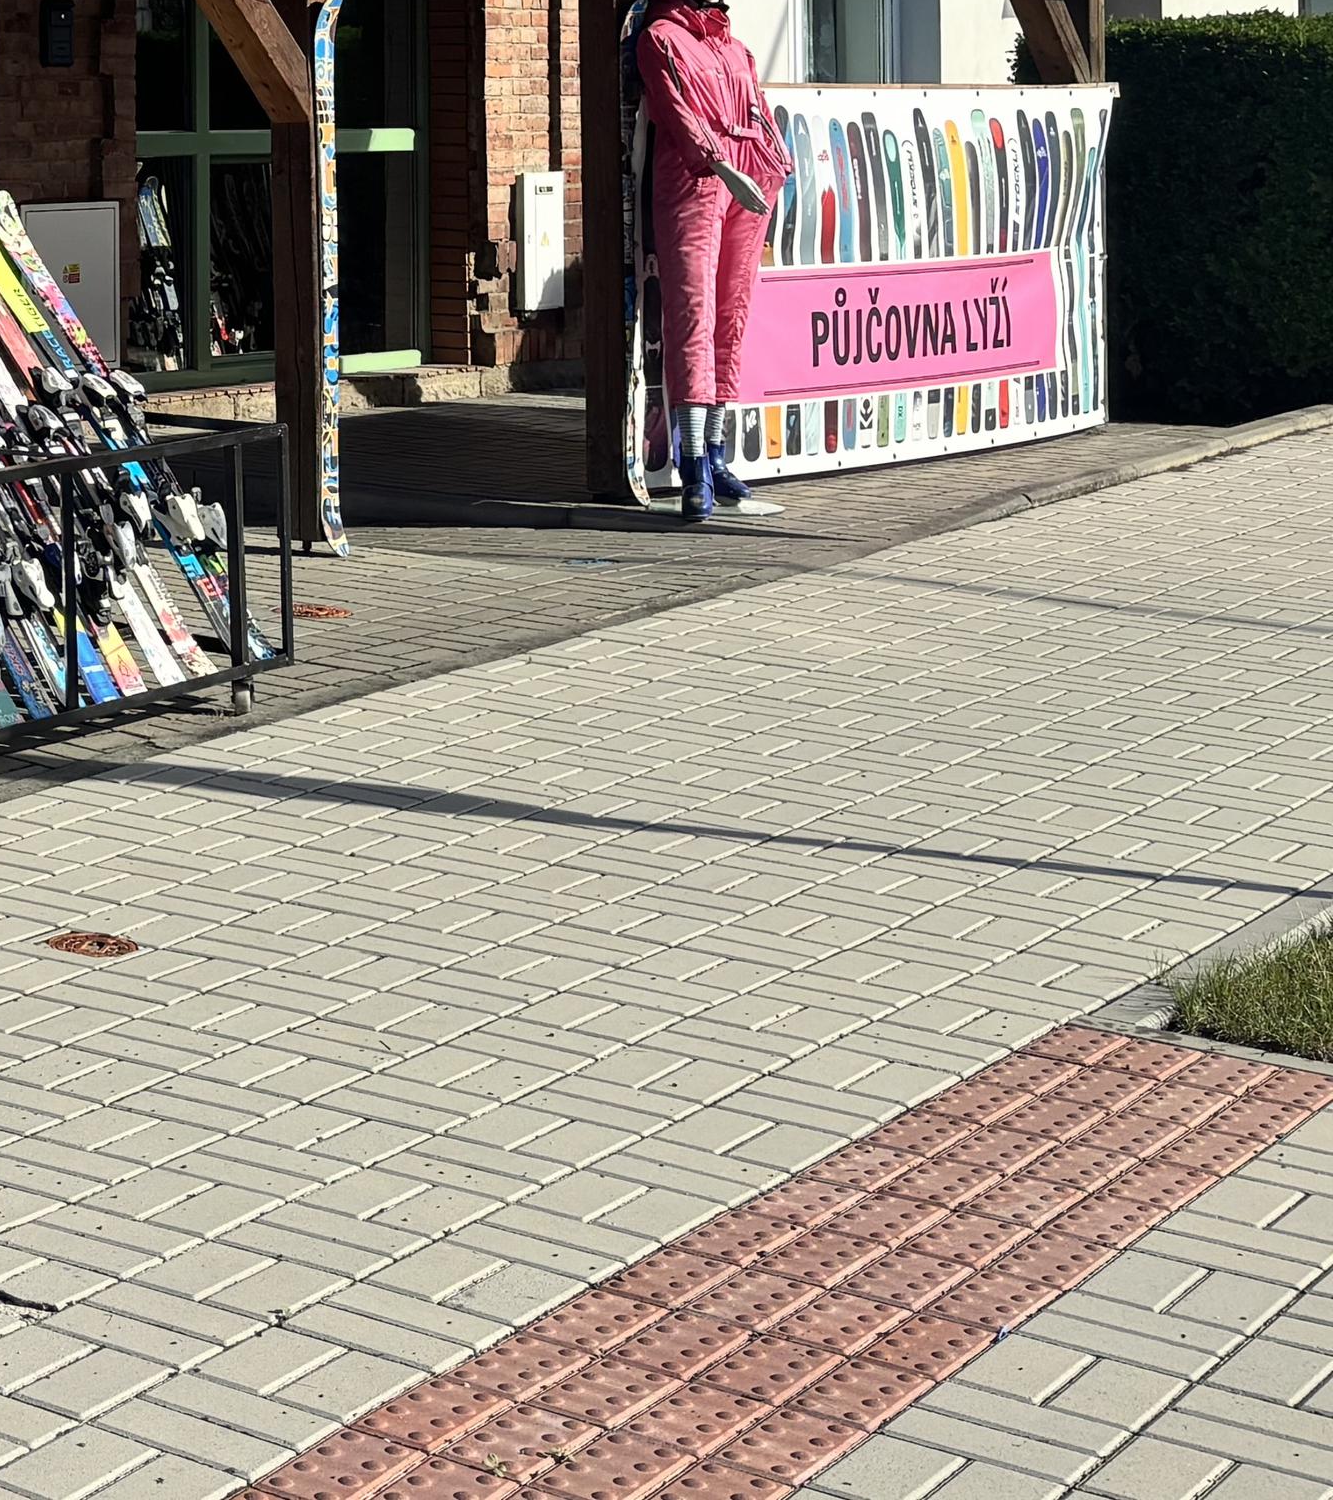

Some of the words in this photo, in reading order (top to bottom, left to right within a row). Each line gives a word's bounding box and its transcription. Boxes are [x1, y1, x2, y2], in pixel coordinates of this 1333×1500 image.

[13, 288, 45, 328] TIGER
[811, 287, 958, 368] PŮJČOVNA
[963, 276, 1012, 353] LYŽÍ
[42, 329, 76, 369] RACE
